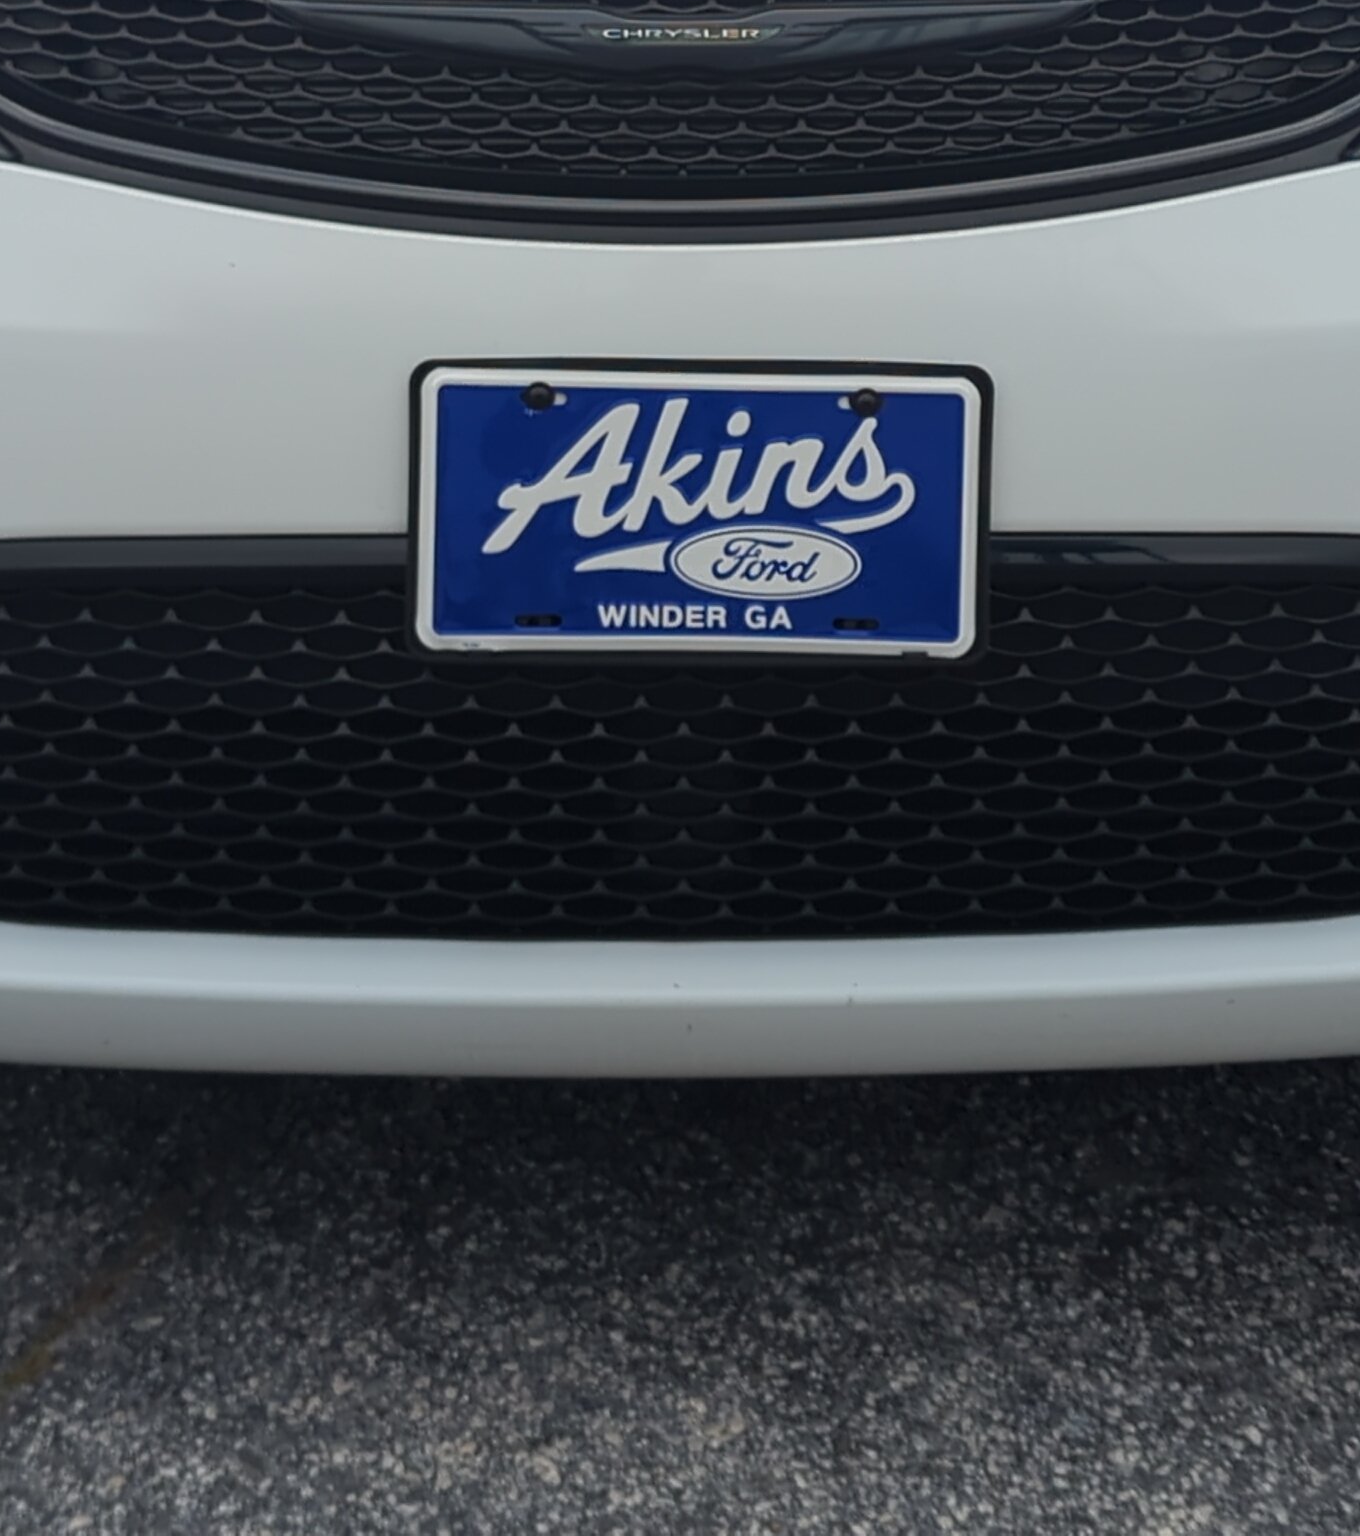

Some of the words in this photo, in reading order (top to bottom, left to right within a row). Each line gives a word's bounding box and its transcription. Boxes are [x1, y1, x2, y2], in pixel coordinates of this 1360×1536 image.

[601, 27, 761, 40] CHRYSLER
[481, 396, 916, 555] Akins
[711, 536, 821, 584] Ford
[597, 603, 728, 629] WINDER
[743, 604, 793, 630] GA
